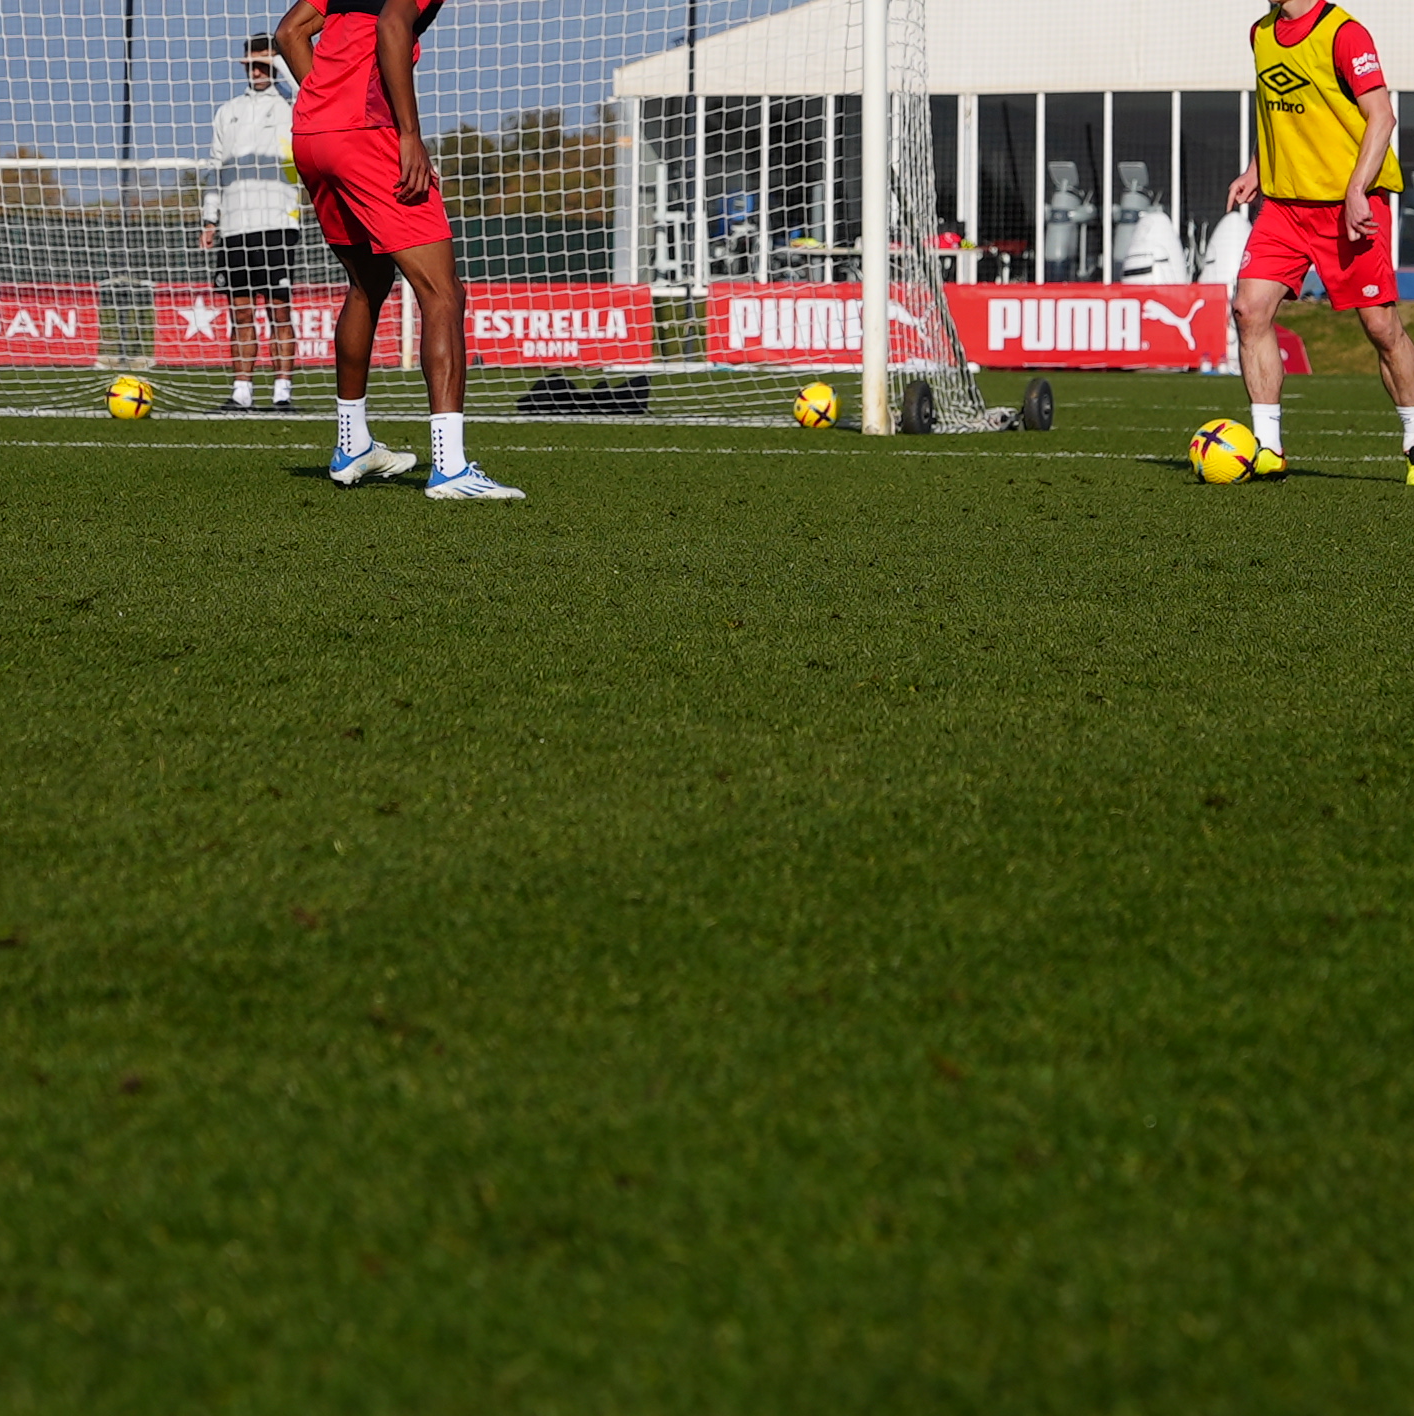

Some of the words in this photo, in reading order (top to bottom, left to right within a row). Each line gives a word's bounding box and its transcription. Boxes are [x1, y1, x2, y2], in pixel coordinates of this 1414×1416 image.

[1267, 99, 1305, 114] mbro
[473, 308, 629, 339] ESTRELLA
[988, 298, 1141, 351] PUMA
